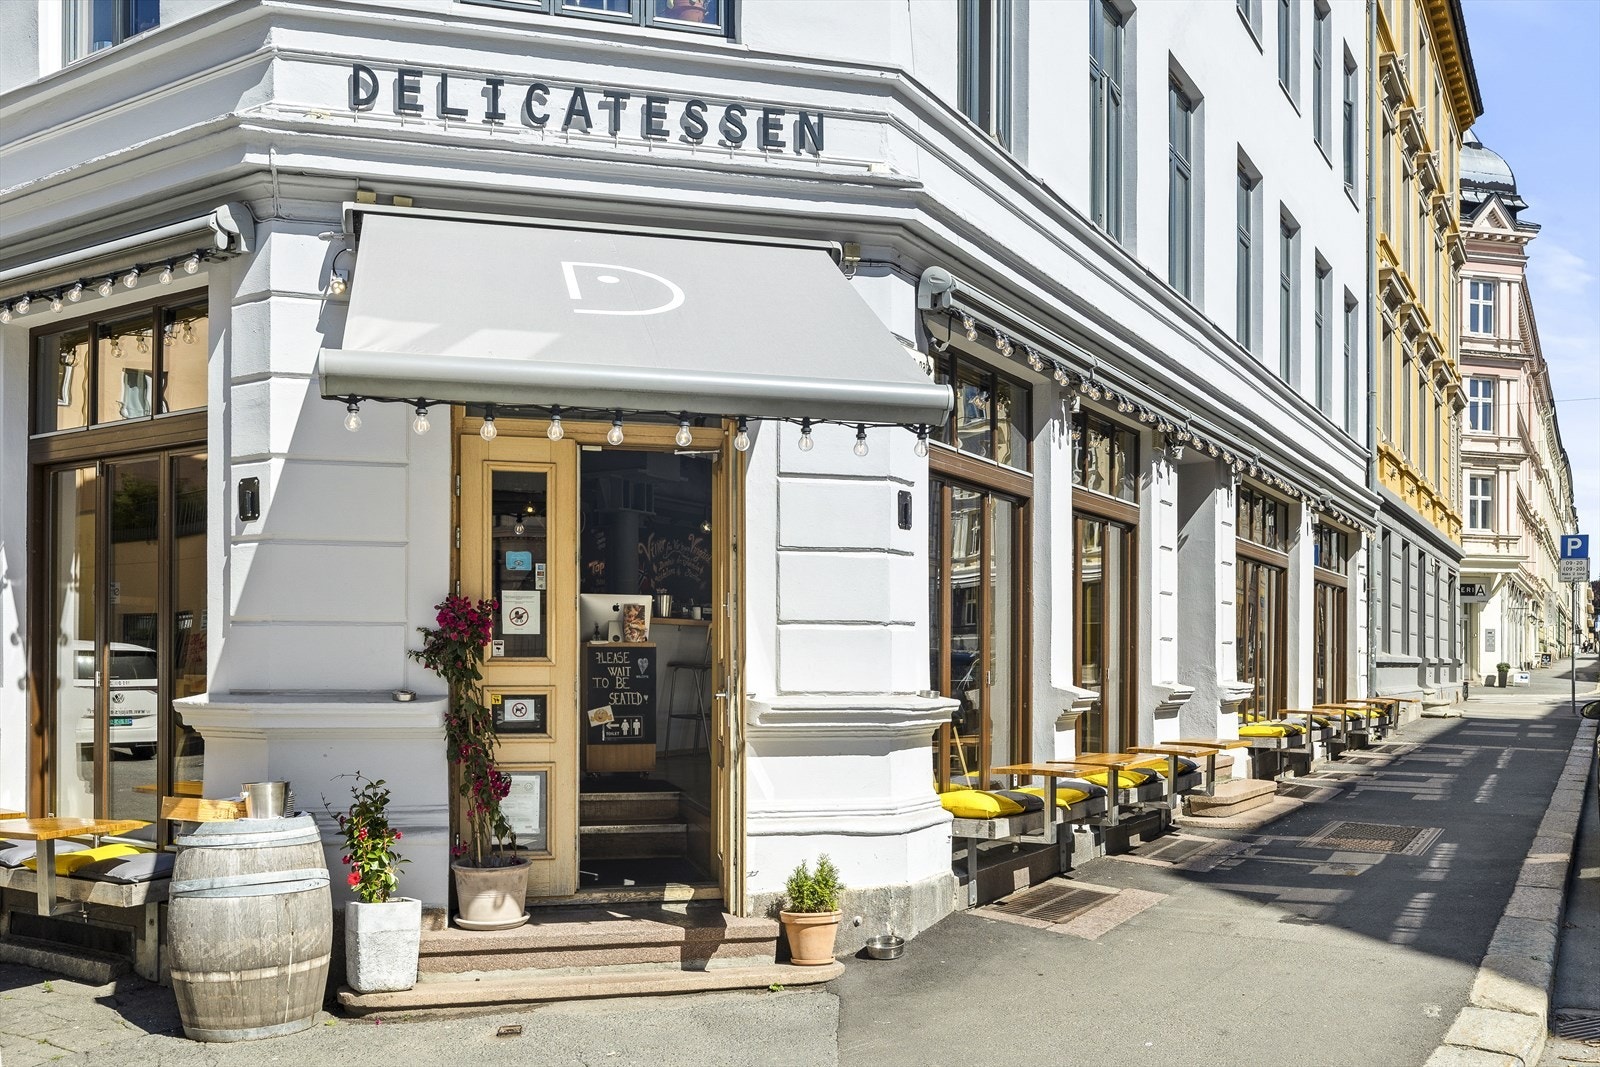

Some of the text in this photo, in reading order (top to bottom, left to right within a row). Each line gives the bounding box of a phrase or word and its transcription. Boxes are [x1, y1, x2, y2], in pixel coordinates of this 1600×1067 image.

[352, 63, 824, 151] DELICATESSEN
[1567, 537, 1582, 557] P
[595, 651, 630, 664] PLEASE
[607, 666, 631, 677] WAIT
[592, 676, 630, 689] TO BE
[608, 691, 642, 706] SEATED
